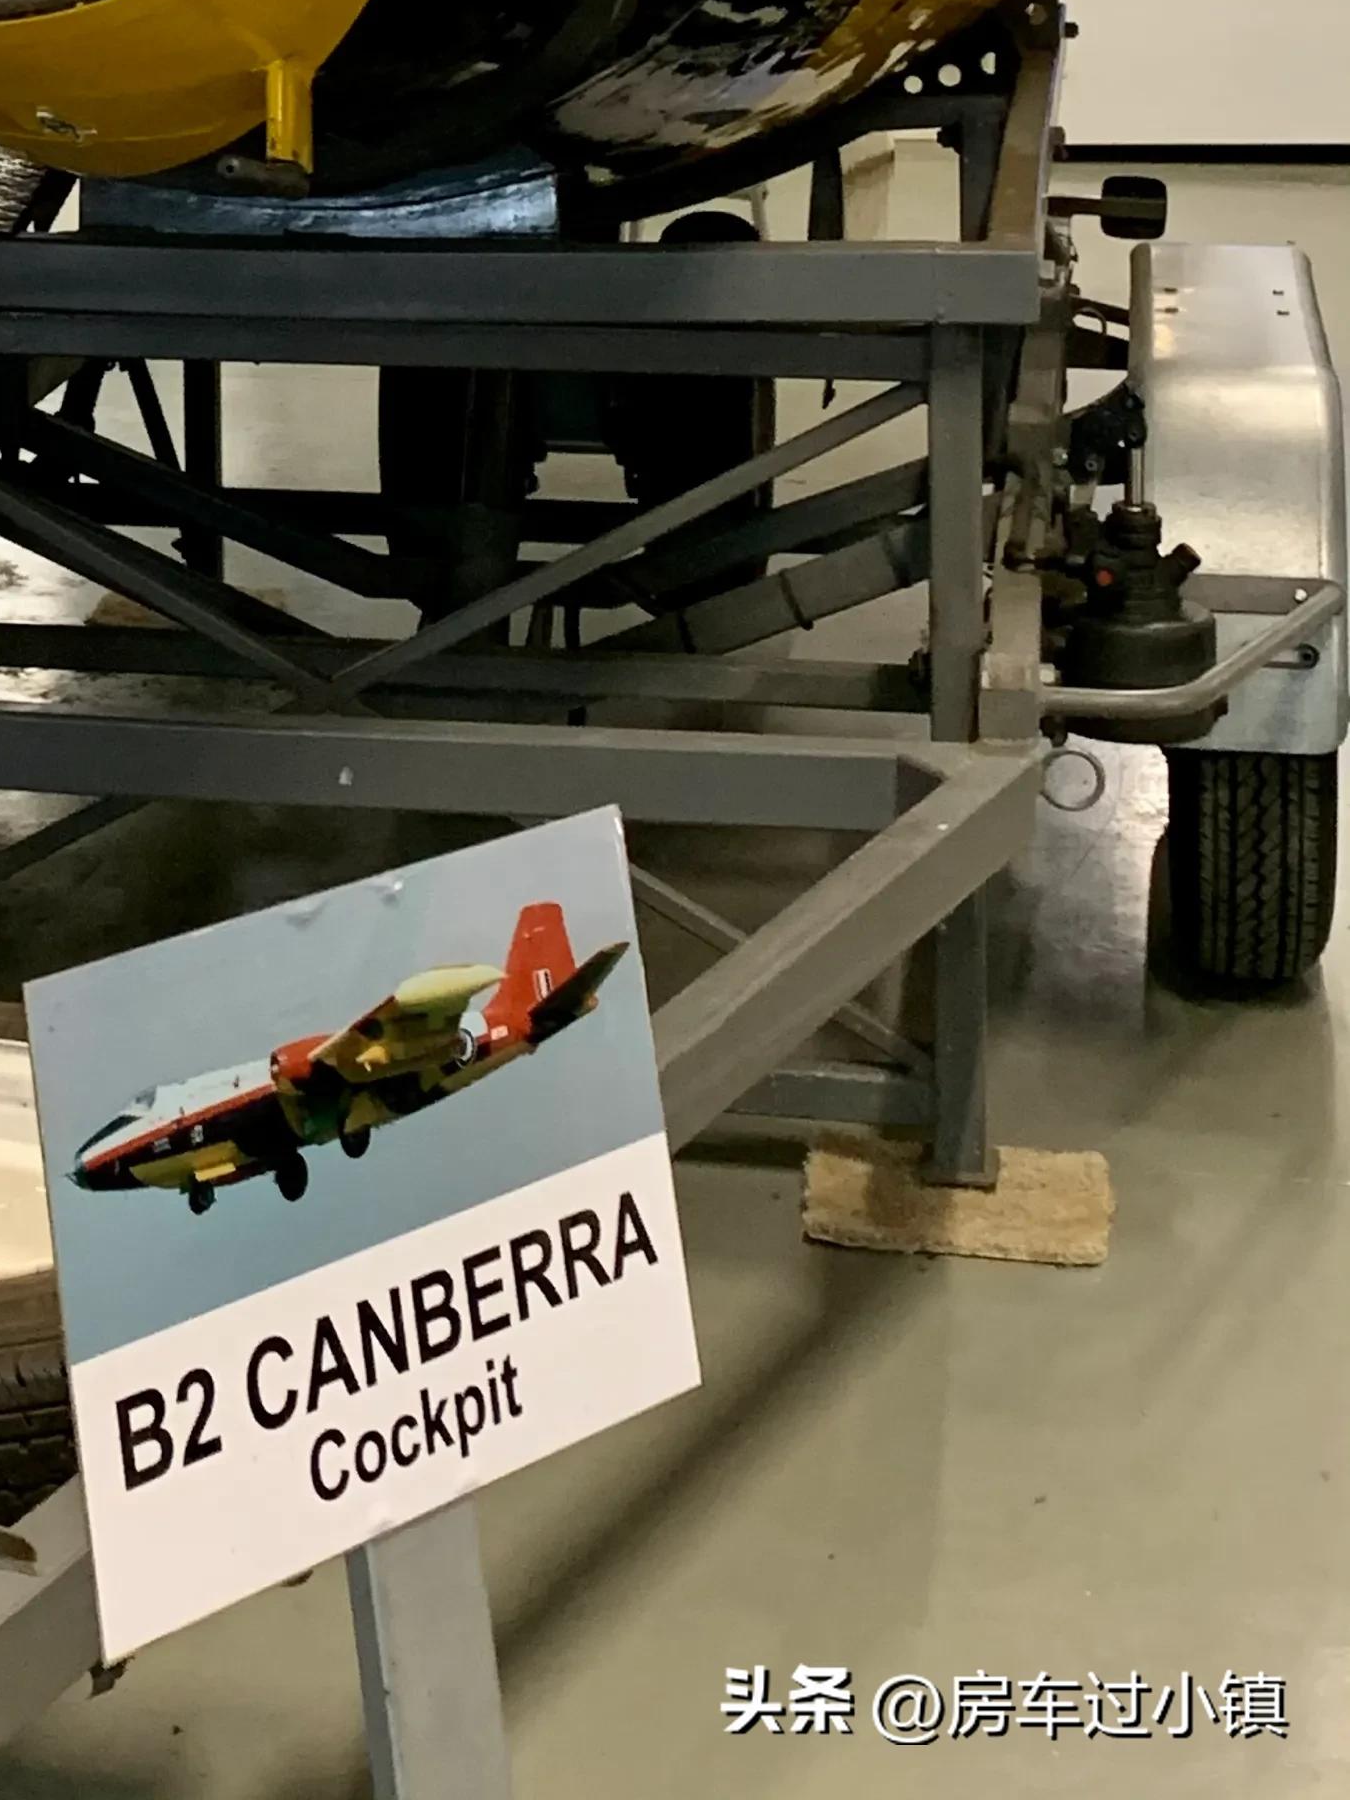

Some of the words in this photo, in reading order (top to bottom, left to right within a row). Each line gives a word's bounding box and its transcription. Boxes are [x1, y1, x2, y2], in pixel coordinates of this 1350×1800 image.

[114, 1367, 222, 1491] B2
[245, 1191, 658, 1430] CANBERRA
[310, 1354, 524, 1502] Cockpit
